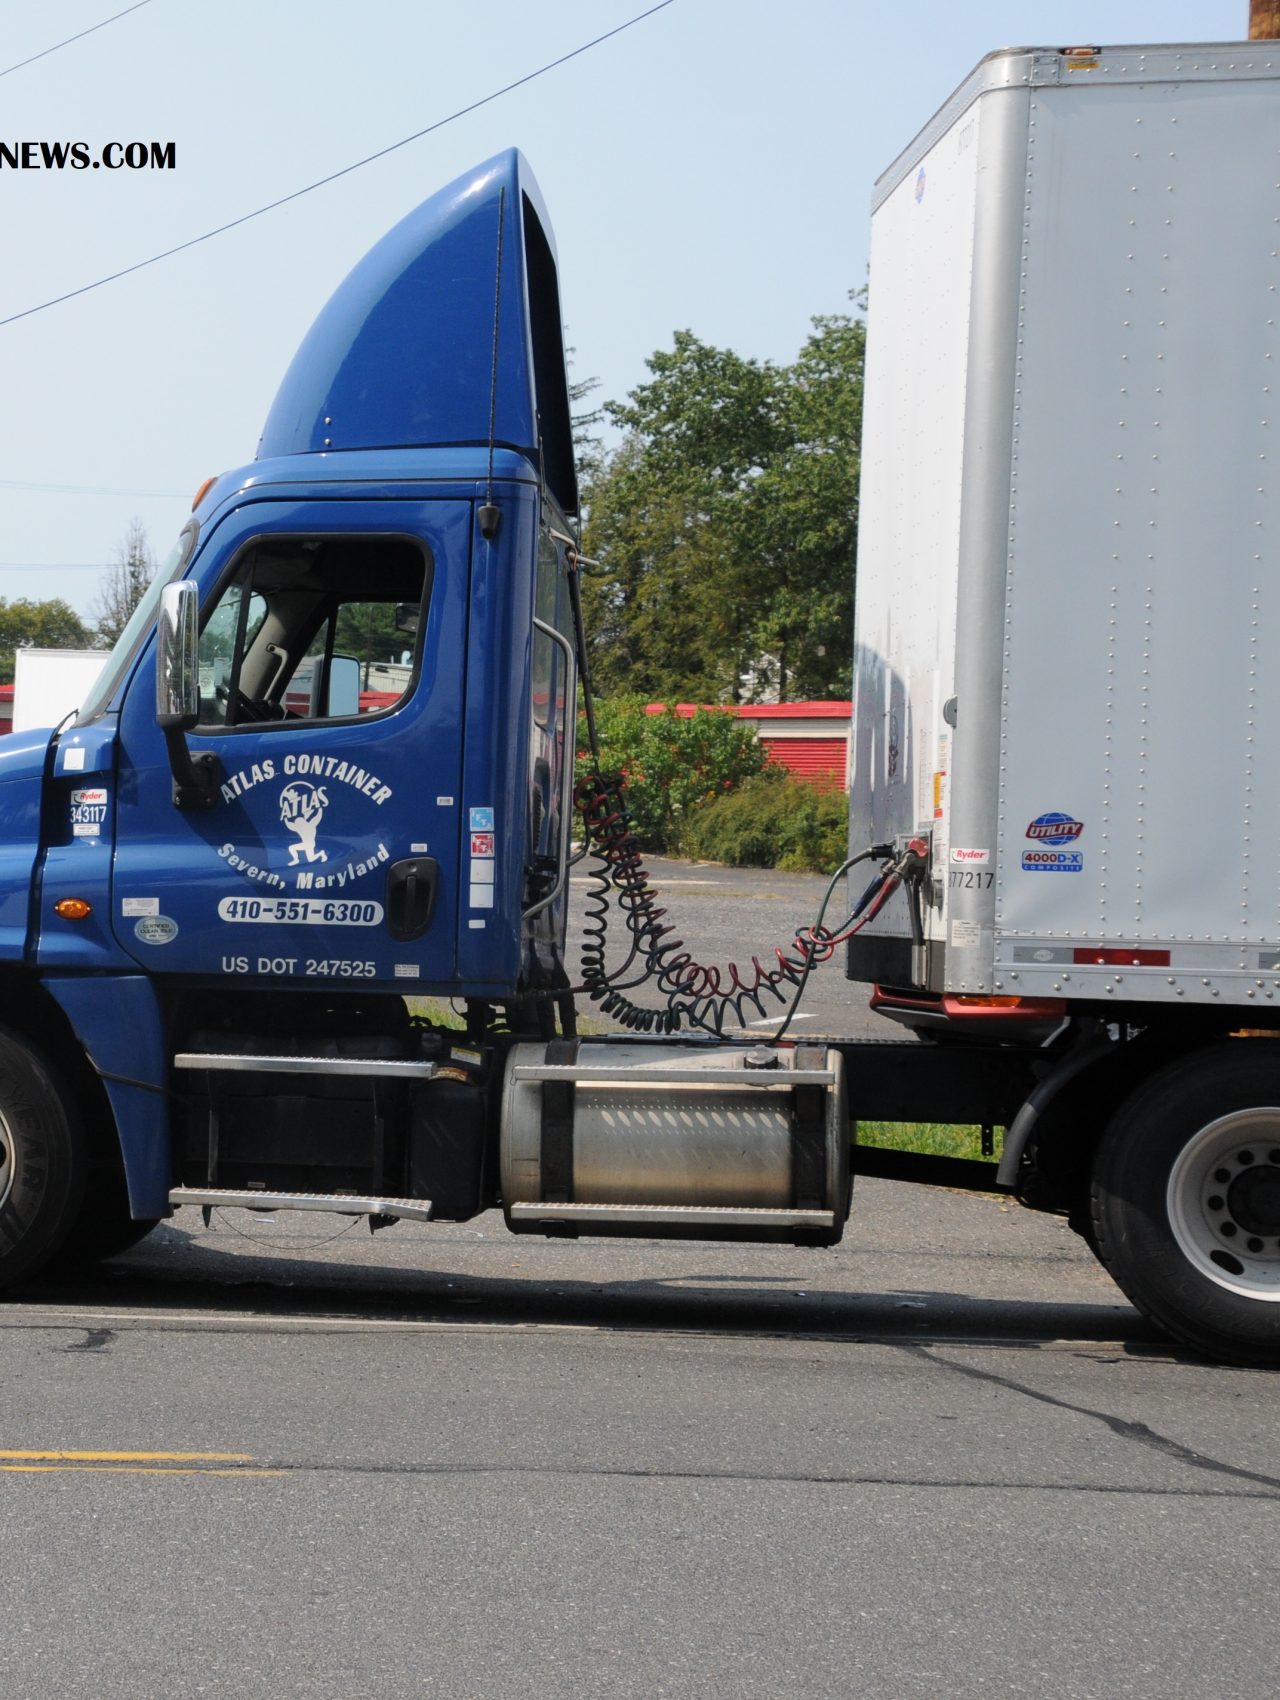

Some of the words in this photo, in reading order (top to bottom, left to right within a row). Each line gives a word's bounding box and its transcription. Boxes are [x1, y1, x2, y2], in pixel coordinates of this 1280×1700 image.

[220, 759, 275, 804] ATLAS
[283, 754, 393, 805] CONTAINER
[80, 792, 103, 801] Ryder
[280, 786, 329, 821] ATLAS
[70, 806, 107, 823] 343117
[1029, 823, 1082, 837] UTILITY
[956, 850, 986, 859] Ryder
[1025, 853, 1080, 863] 4000D-X
[217, 843, 286, 890] Severn,
[296, 843, 390, 890] Maryland
[949, 871, 995, 889] 77217
[226, 900, 376, 922] 410-551-6300
[222, 956, 249, 973] US
[257, 958, 297, 974] DOT
[305, 960, 376, 977] 247525
